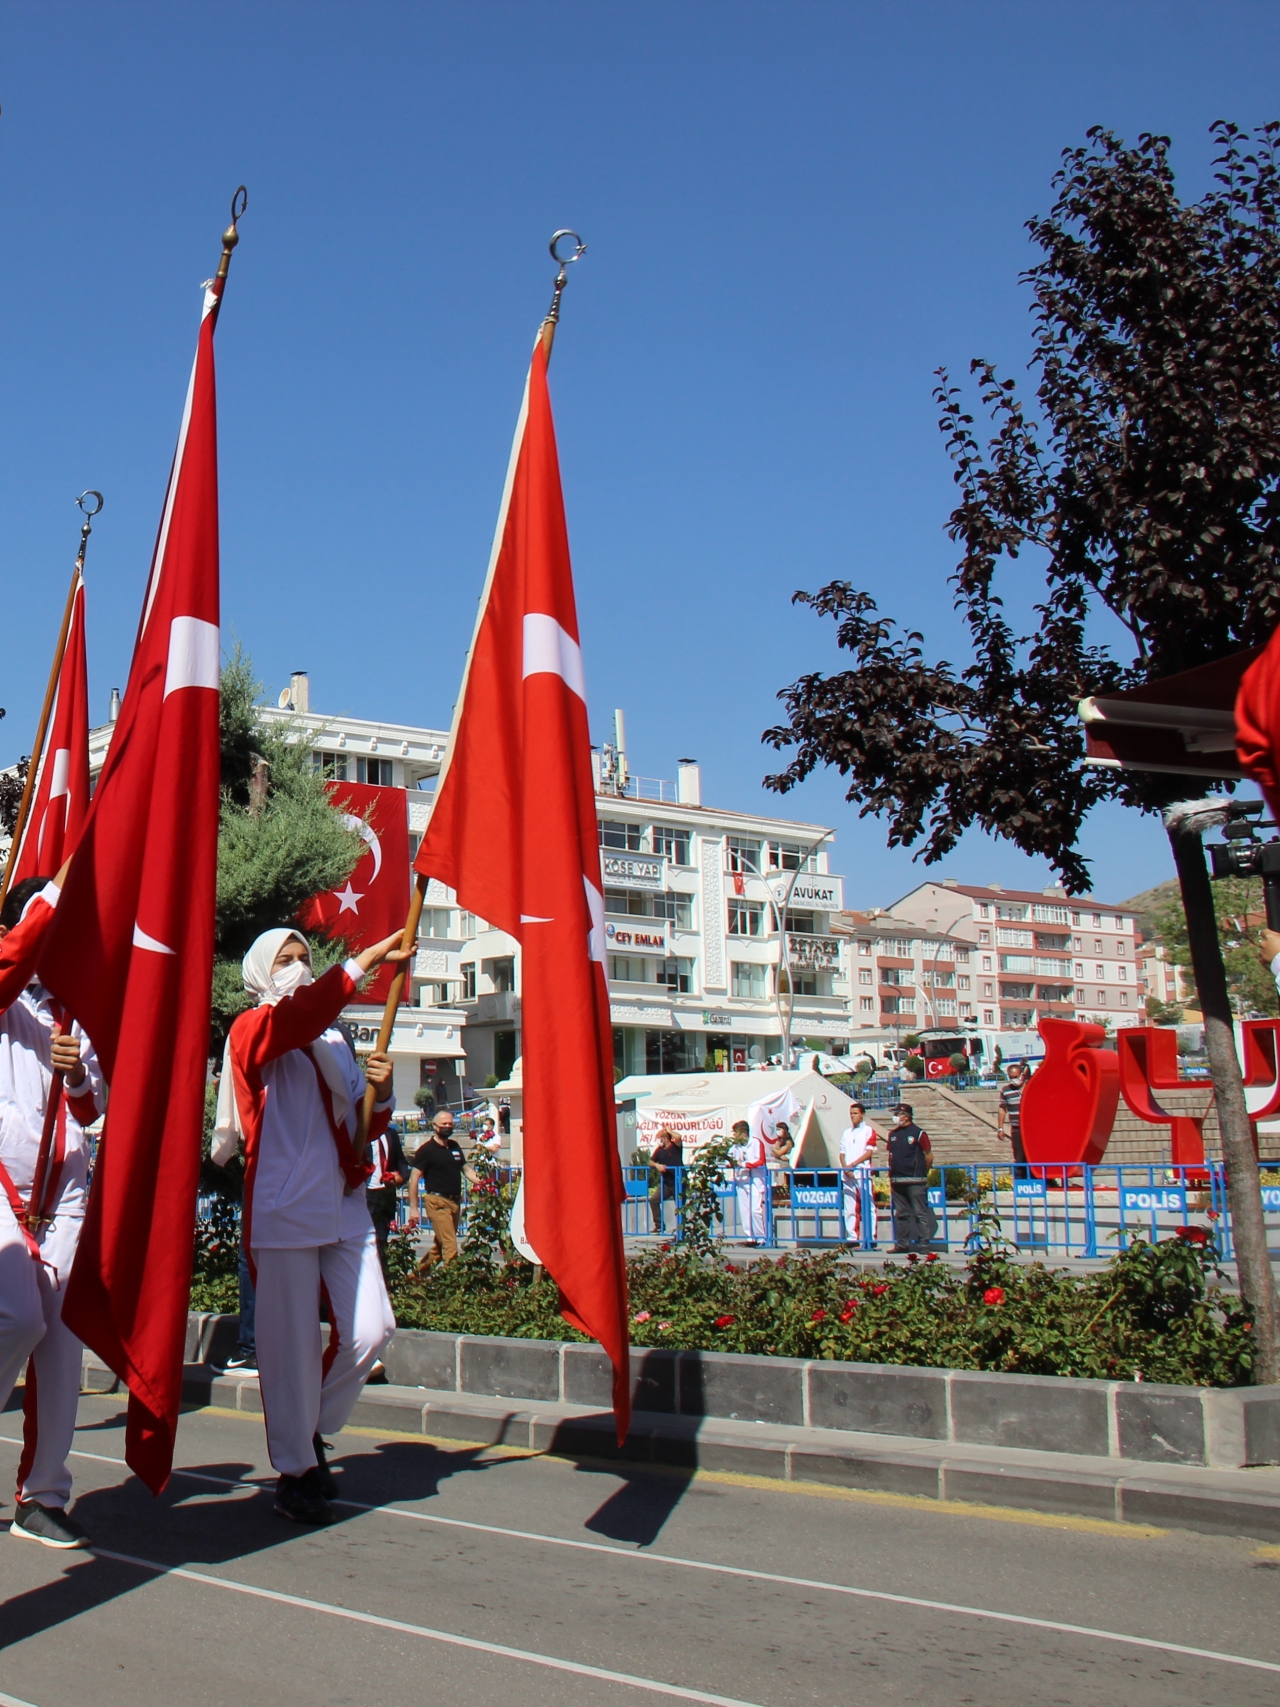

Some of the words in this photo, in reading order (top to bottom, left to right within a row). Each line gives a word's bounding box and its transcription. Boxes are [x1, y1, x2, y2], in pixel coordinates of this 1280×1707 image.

[793, 886, 834, 901] AVUKAT
[634, 933, 665, 947] EMLAK
[654, 1110, 687, 1120] YOZGAT
[1017, 1184, 1042, 1194] POLİS
[795, 1190, 838, 1204] YOZGAT
[1125, 1190, 1181, 1209] POLİS
